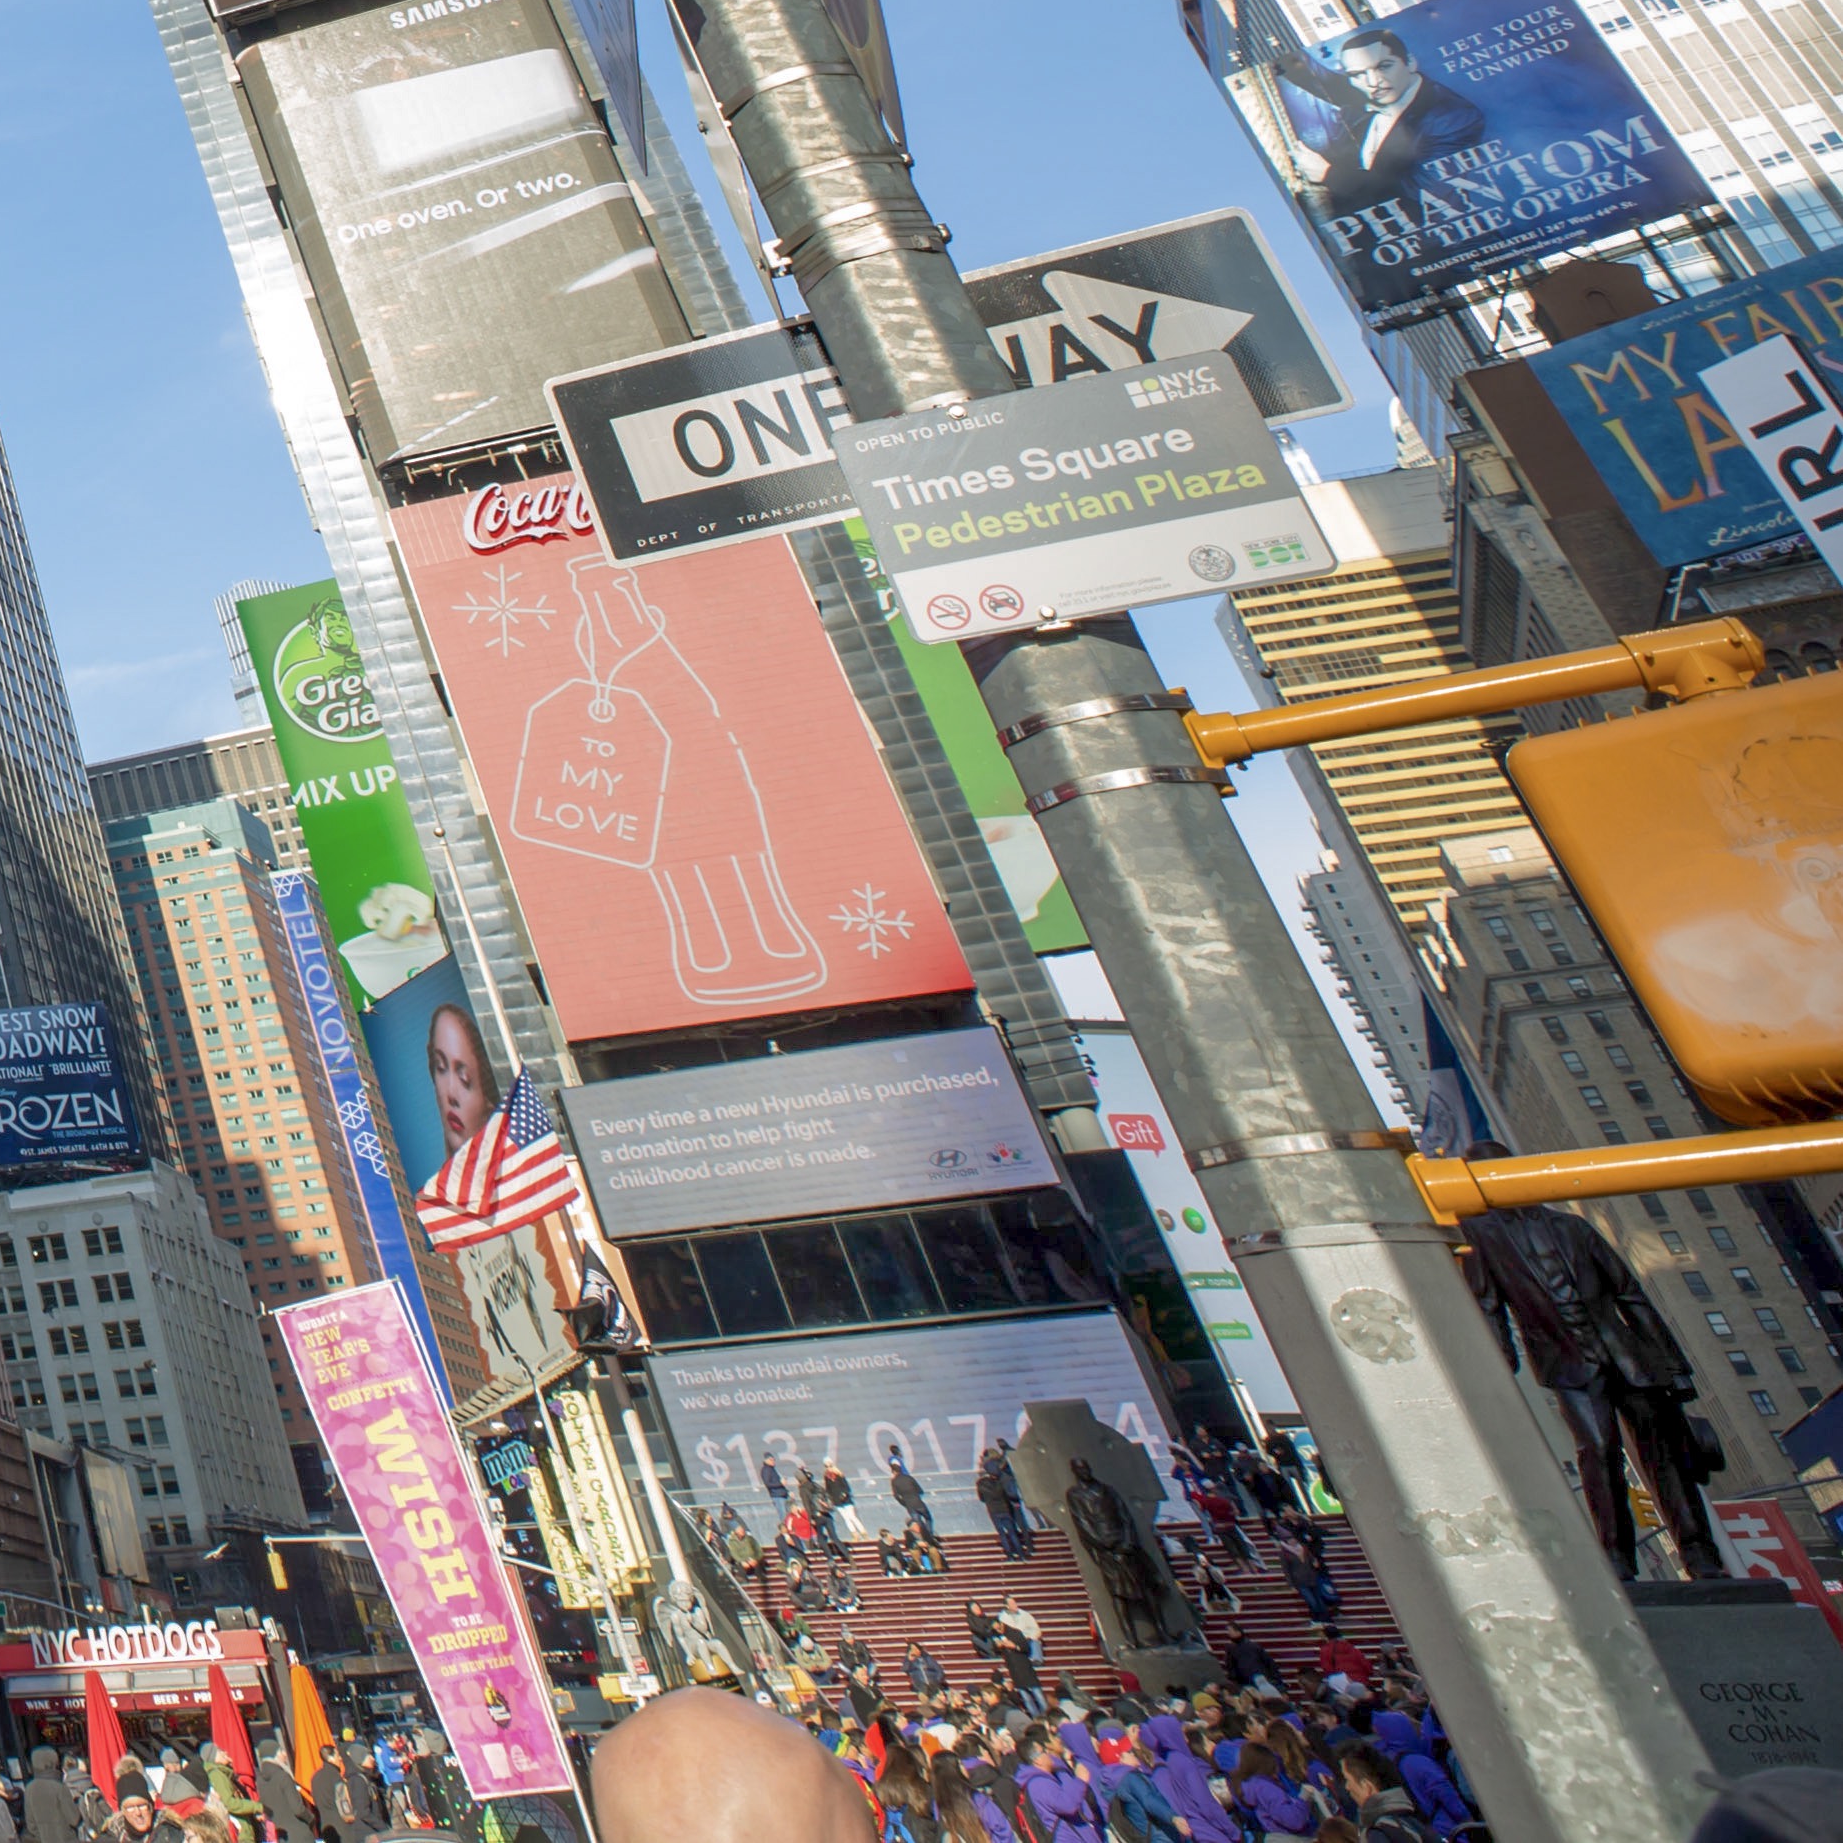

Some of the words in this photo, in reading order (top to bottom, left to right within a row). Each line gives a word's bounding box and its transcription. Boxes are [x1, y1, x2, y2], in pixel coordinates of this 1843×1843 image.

[1438, 33, 1485, 59] LET
[1495, 5, 1565, 39] YOUR
[1441, 16, 1576, 74] FANTASIES
[1465, 39, 1571, 84] UNWIND
[1424, 139, 1512, 182] THE
[1322, 115, 1665, 257] PHANTOM
[336, 211, 392, 247] One
[397, 196, 471, 232] oven.
[476, 182, 511, 212] Or
[514, 167, 582, 204] two.
[1372, 232, 1427, 267] OF
[1427, 203, 1513, 249] THE
[1513, 164, 1651, 222] OPERA
[1157, 367, 1215, 393] NYC
[1166, 381, 1222, 403] PLAZA
[1569, 331, 1685, 415] MY
[856, 432, 897, 452] OPEN
[901, 427, 926, 443] TO
[929, 411, 1005, 441] PUBLIC
[872, 451, 1014, 511] Times
[1019, 428, 1196, 482] Square
[893, 490, 1134, 556] Pedestrian
[1134, 463, 1267, 507] Plaza
[636, 529, 678, 547] DEPT
[698, 522, 717, 535] OF
[580, 736, 616, 758] TO
[355, 764, 396, 797] UP
[561, 761, 623, 798] MY
[535, 798, 638, 843] LOVE
[293, 890, 353, 1075] NOVOTEL
[41, 1006, 96, 1029] SNOW
[590, 1113, 649, 1140] Every
[651, 1107, 694, 1131] time
[715, 1100, 759, 1121] new
[760, 1084, 852, 1121] Hyundai
[854, 1082, 871, 1103] is
[874, 1067, 1000, 1105] purchased,
[615, 1135, 704, 1164] donation
[707, 1130, 731, 1151] to
[734, 1123, 782, 1152] help
[787, 1116, 835, 1147] fight
[1115, 1120, 1158, 1144] Gift
[608, 1162, 710, 1193] childhood
[713, 1155, 783, 1179] cancer
[786, 1149, 804, 1170] is
[807, 1141, 874, 1168] made.
[927, 1167, 978, 1182] HYUNDAI
[297, 1312, 334, 1332] SUBMIT
[303, 1326, 341, 1349] NEW
[311, 1338, 371, 1370] YEAR'S
[671, 1364, 734, 1388] Thanks
[736, 1365, 754, 1380] to
[755, 1354, 832, 1384] Hyundai
[835, 1349, 908, 1374] owners,
[315, 1361, 352, 1387] EVE
[734, 1380, 813, 1405] donated:
[328, 1377, 418, 1412] CONFETTI
[566, 1401, 596, 1472] OLIVE
[589, 1477, 626, 1565] GARDEN
[364, 1407, 479, 1606] WISH
[31, 1628, 81, 1666] NYC
[89, 1620, 225, 1662] HOTDOGS
[427, 1622, 509, 1655] DROPPED
[153, 1693, 180, 1706] BEER
[1700, 1681, 1804, 1704] GEORGE
[1728, 1722, 1822, 1745] COHAN
